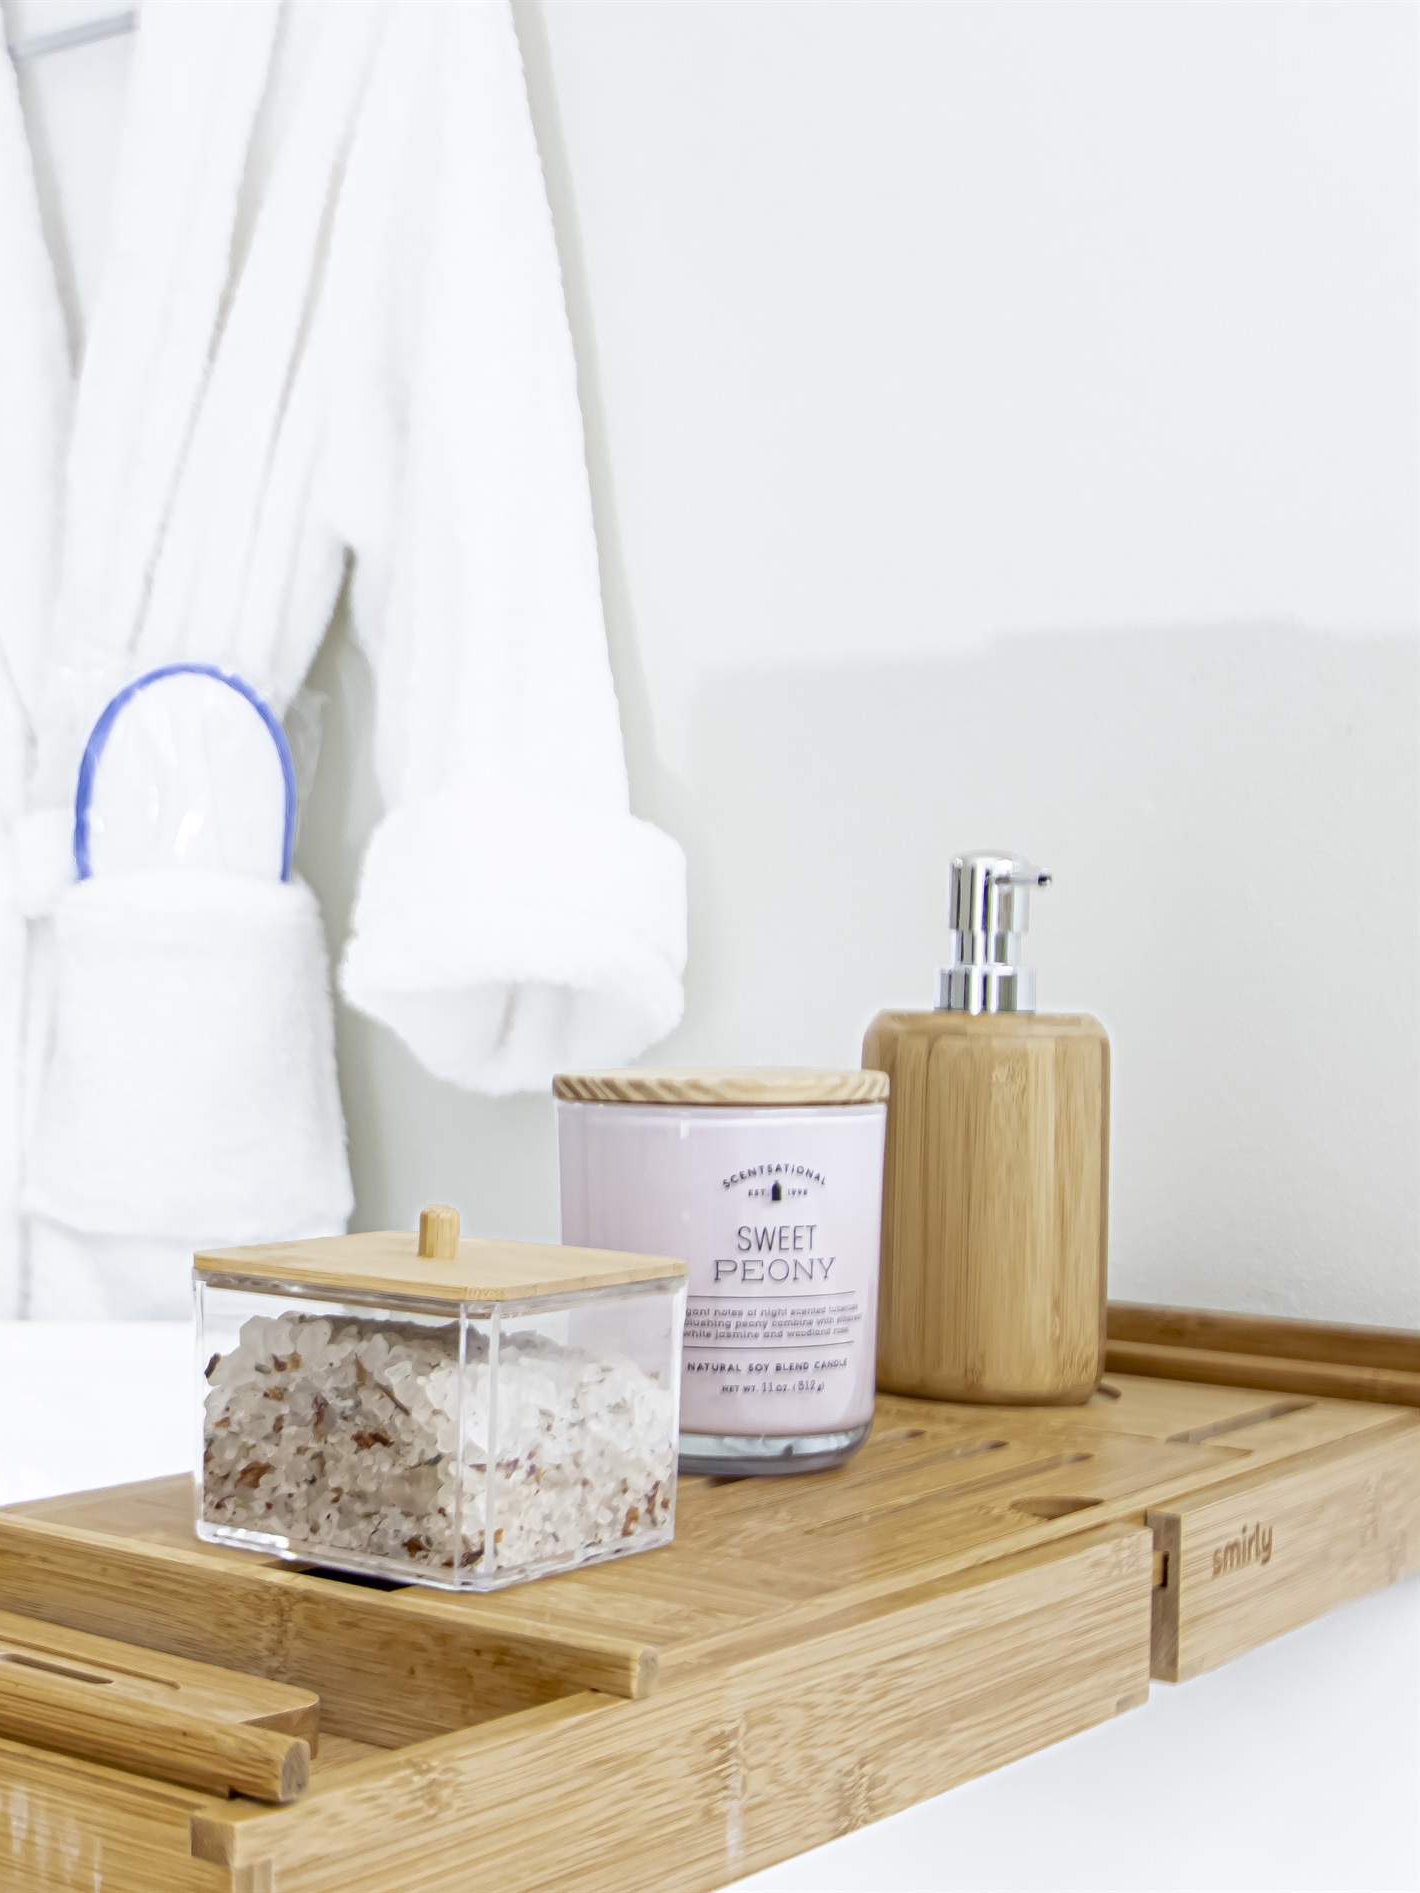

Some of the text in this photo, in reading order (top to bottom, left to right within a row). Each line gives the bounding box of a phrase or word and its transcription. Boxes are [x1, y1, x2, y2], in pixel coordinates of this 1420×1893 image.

[722, 1163, 826, 1190] SCENTSATIONAL
[737, 1224, 818, 1252] SWEET
[713, 1256, 836, 1283] PEONY
[686, 1308, 710, 1317] gant
[714, 1308, 744, 1316] notes
[747, 1308, 757, 1316] of
[760, 1307, 787, 1318] night
[790, 1305, 826, 1316] scented
[735, 1320, 768, 1330] peony
[771, 1318, 813, 1327] combine
[816, 1317, 835, 1325] with
[683, 1329, 712, 1338] white
[715, 1329, 760, 1340] jasmine
[763, 1330, 784, 1338] and
[787, 1327, 832, 1337] woodland
[687, 1357, 848, 1373] NATURAL SOY BLEND CANDLE
[722, 1384, 740, 1393] NET
[1212, 1521, 1273, 1578] smirly
